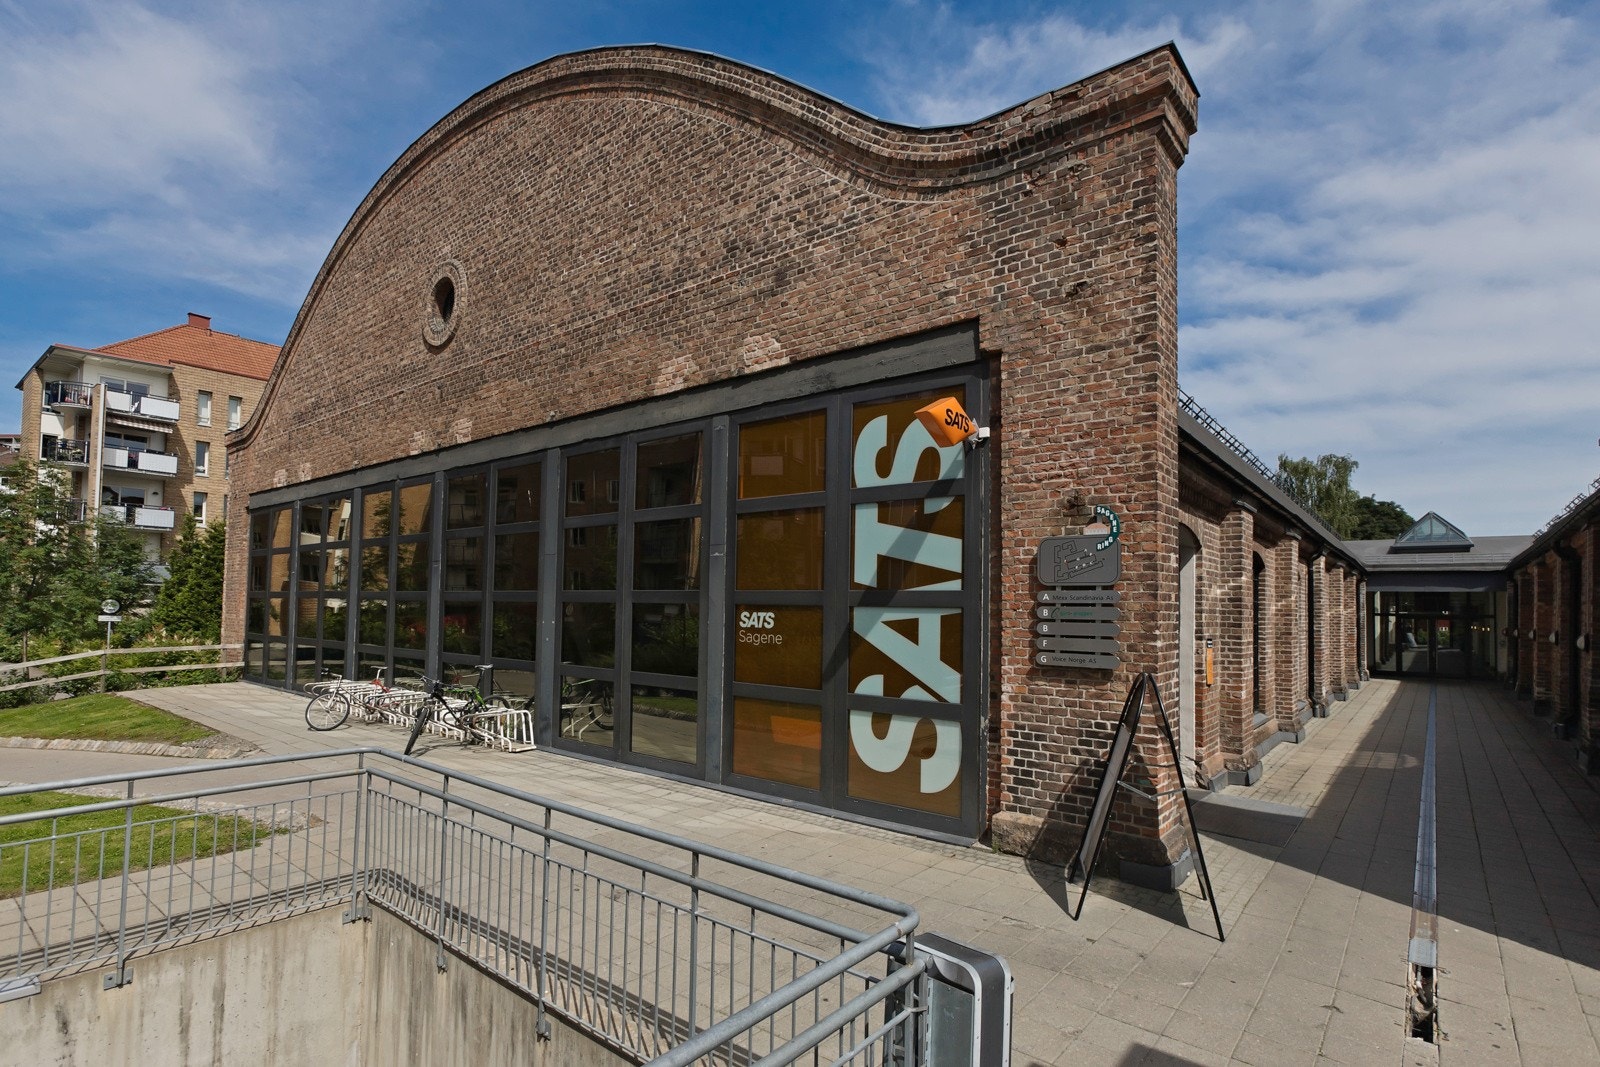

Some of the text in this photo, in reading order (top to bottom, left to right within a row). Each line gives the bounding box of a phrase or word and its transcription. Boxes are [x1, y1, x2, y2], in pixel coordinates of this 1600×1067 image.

[944, 408, 970, 433] SATS
[1096, 506, 1117, 533] SAGENE
[1097, 536, 1114, 550] RING
[849, 414, 965, 793] SATS
[1042, 593, 1050, 601] A
[739, 611, 776, 629] SATS
[1042, 609, 1049, 617] B
[1042, 624, 1048, 632] B
[738, 629, 783, 646] Sagene
[1040, 655, 1047, 663] G
